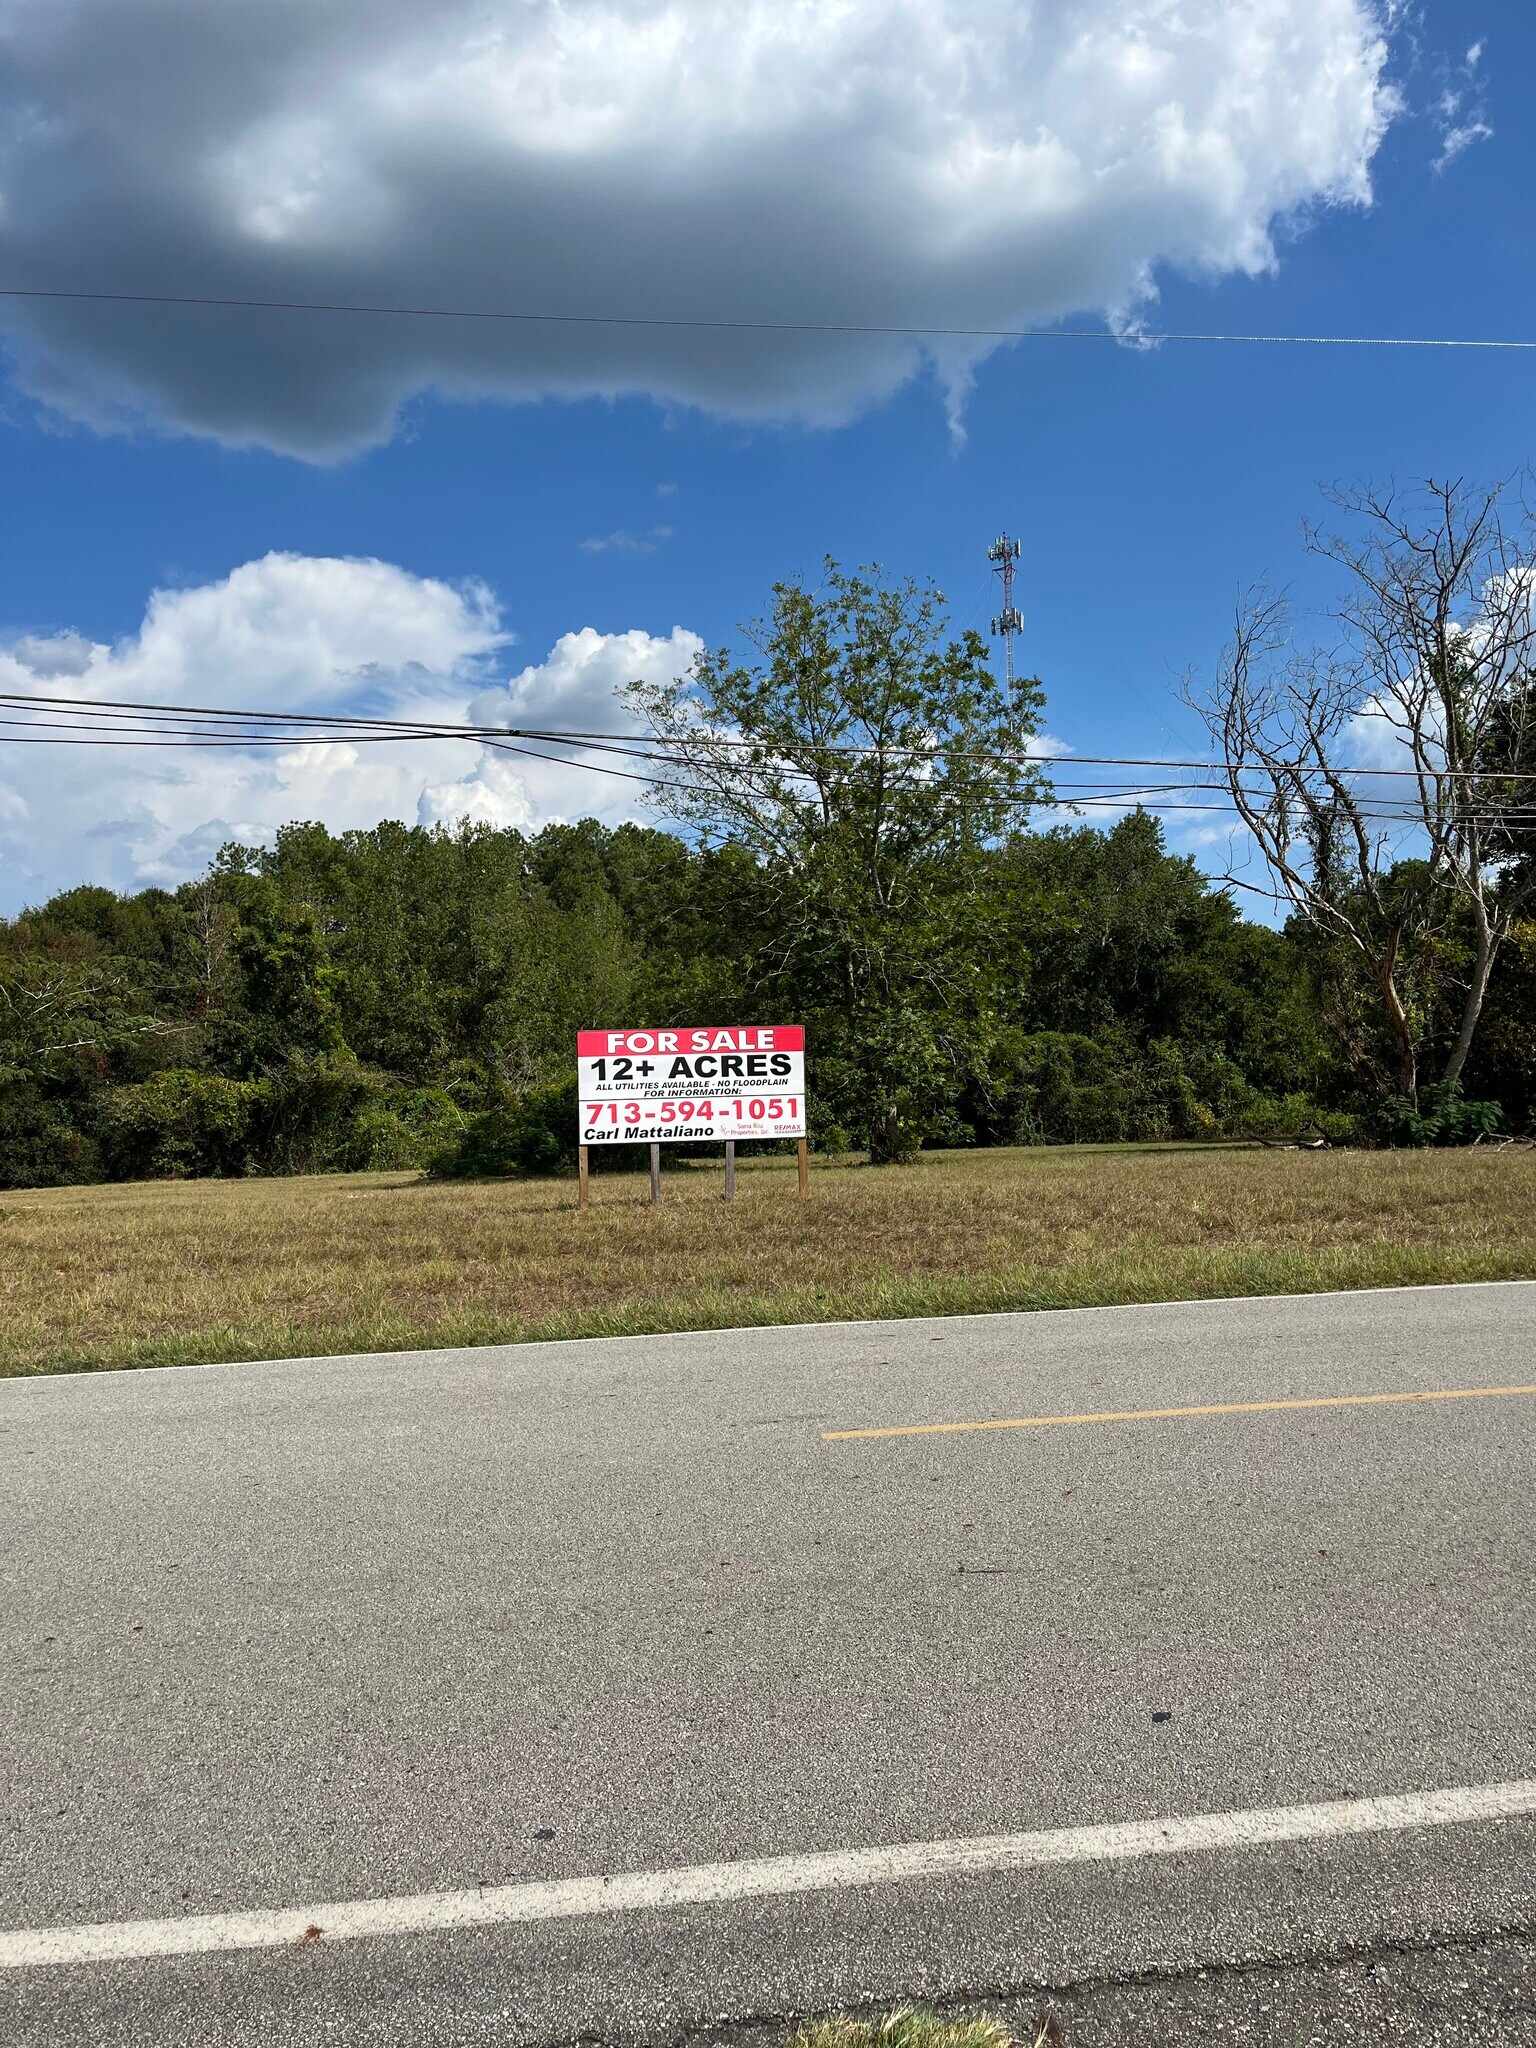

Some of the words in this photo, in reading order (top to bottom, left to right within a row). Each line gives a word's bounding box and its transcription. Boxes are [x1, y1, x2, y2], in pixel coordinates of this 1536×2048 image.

[607, 1031, 680, 1054] FOR
[690, 1029, 775, 1052] SALE
[591, 1057, 655, 1081] 12+
[668, 1053, 792, 1079] ACRES
[596, 1083, 613, 1091] ALL
[615, 1082, 660, 1090] UTILITIES
[661, 1080, 710, 1089] AVAILABLE
[733, 1078, 789, 1087] FLOODPLAIN
[644, 1089, 665, 1097] FOR
[667, 1088, 742, 1097] INFORMATION:
[586, 1098, 797, 1125] 713-594-1051
[584, 1127, 619, 1140] Carl
[624, 1125, 714, 1139] Mattaliano
